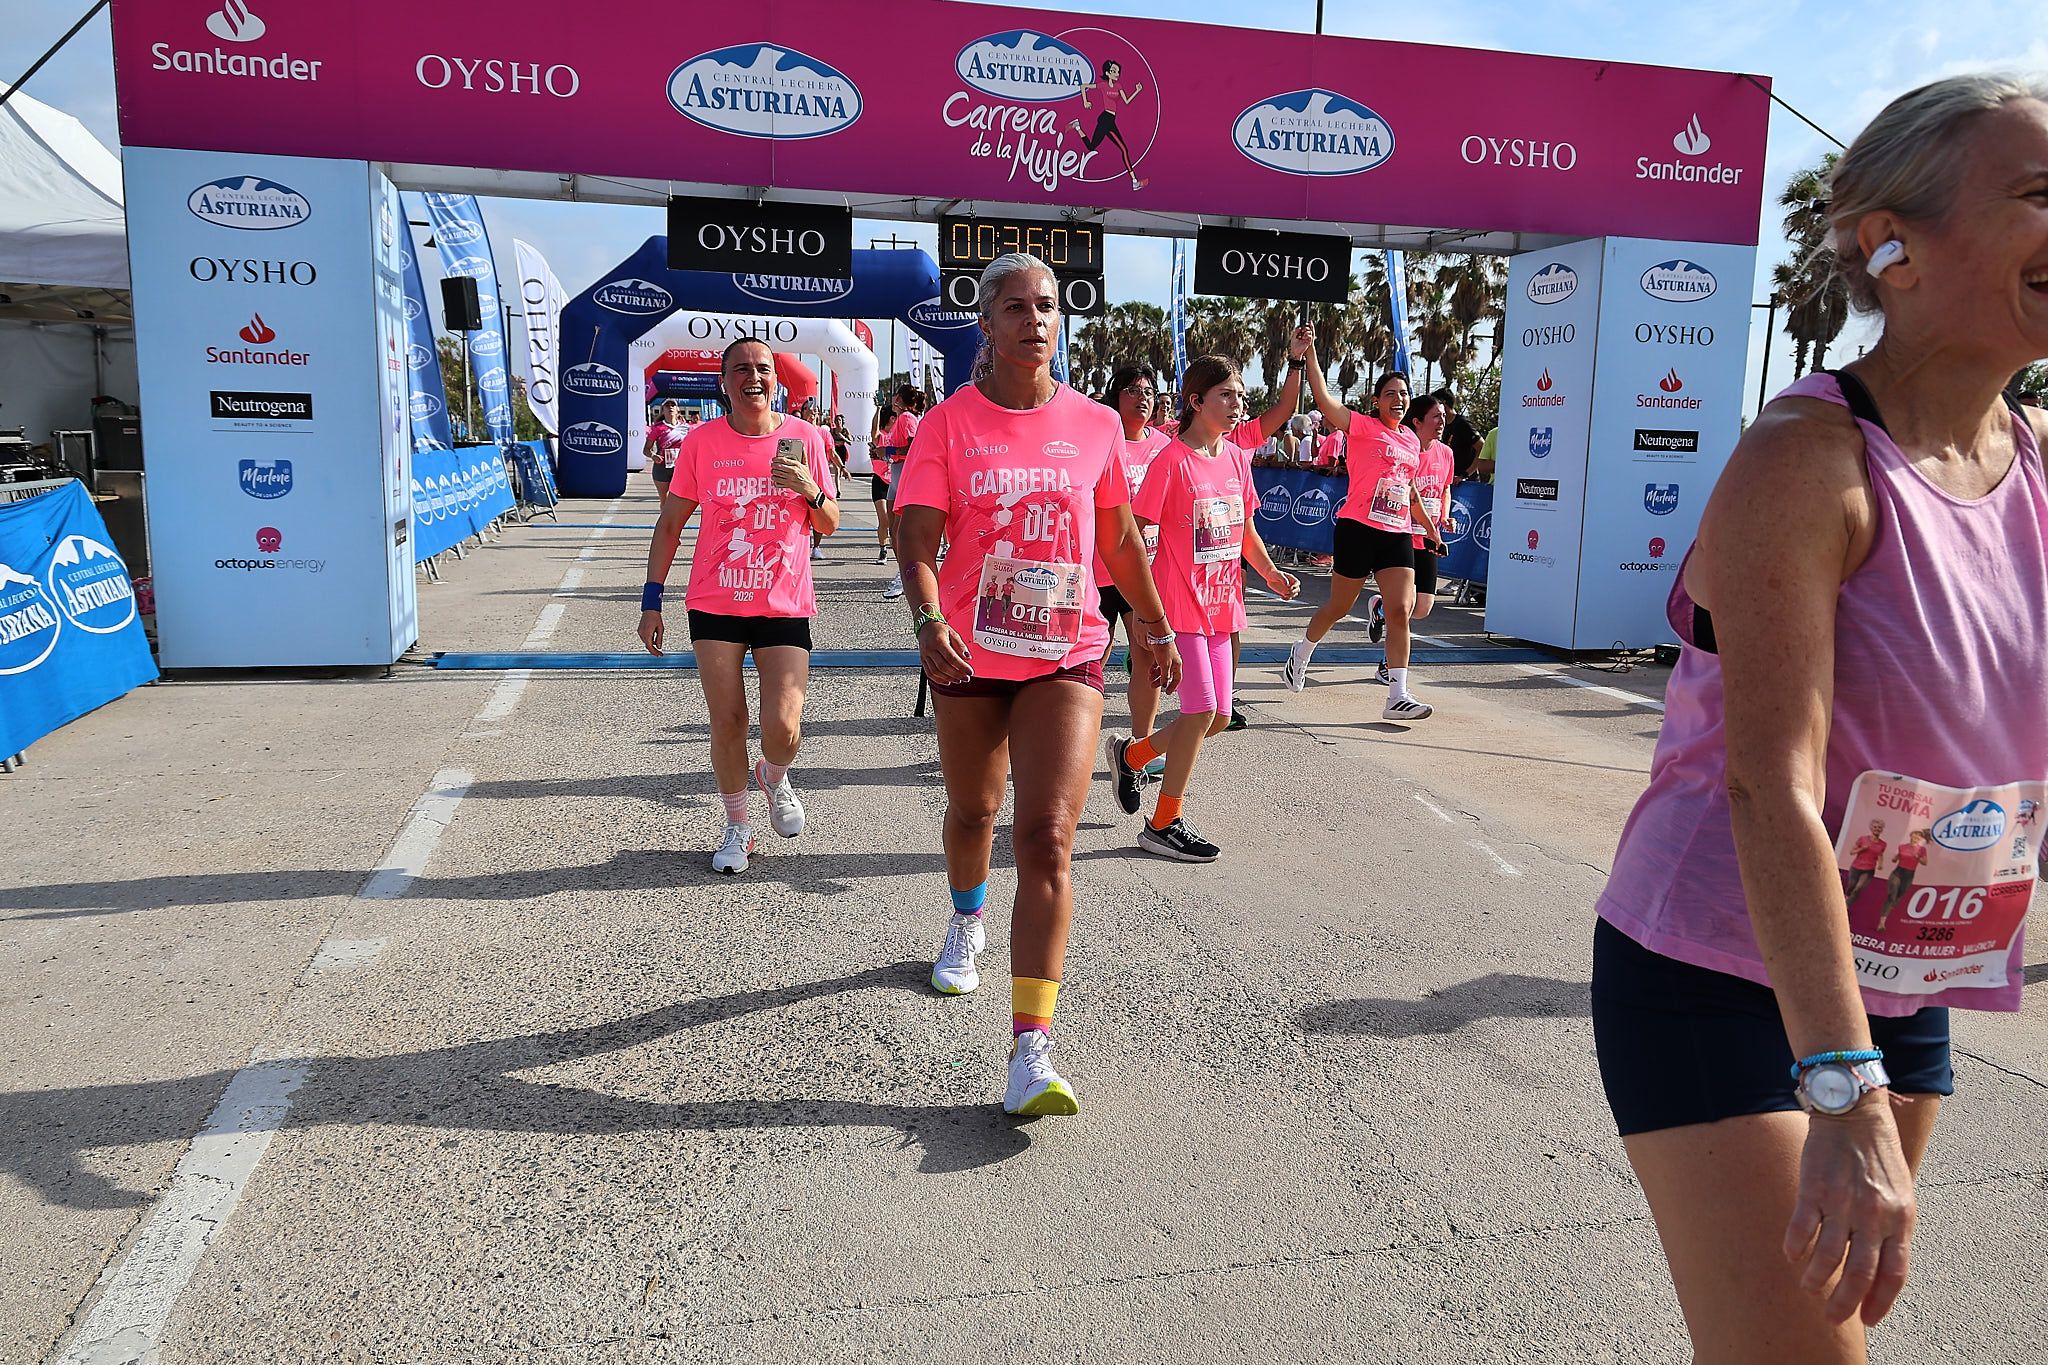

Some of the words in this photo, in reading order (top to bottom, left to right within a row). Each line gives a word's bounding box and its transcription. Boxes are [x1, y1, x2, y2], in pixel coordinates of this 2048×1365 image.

[151, 43, 322, 81] Santander
[966, 51, 1083, 86] ASTURIANA
[988, 51, 1032, 62] CENTRAL
[1036, 56, 1080, 66] LECHERA
[415, 54, 580, 98] OYSHO
[713, 72, 774, 86] CENTRAL
[781, 78, 842, 92] LECHERA
[683, 73, 848, 118] ASTURIANA
[943, 91, 1057, 135] Carrera
[1271, 117, 1323, 128] CENTRAL
[1328, 120, 1378, 132] LECHERA
[1245, 117, 1382, 157] ASTURIANA
[970, 132, 992, 157] de
[997, 132, 1012, 159] la
[1008, 132, 1098, 192] Mujer
[1460, 135, 1577, 171] OYSHO
[1635, 156, 1743, 186] Santander
[197, 193, 303, 219] ASTURIANA
[698, 222, 825, 257] OYSHO
[952, 223, 1092, 264] 00:36:07
[190, 256, 317, 286] OYSHO
[1221, 249, 1329, 281] OYSHO
[742, 274, 844, 293] ASTURIANA
[1530, 280, 1574, 297] ASTURIANA
[1646, 273, 1711, 293] ASTURIANA
[599, 290, 667, 308] ASTURIANA
[688, 316, 797, 343] OYSHO
[1522, 323, 1575, 347] OYSHO
[1635, 323, 1714, 346] OYSHO
[206, 347, 310, 365] Santander
[667, 349, 698, 359] Sports
[828, 345, 860, 354] OYSHO
[566, 373, 620, 390] ASTURIANA
[216, 396, 307, 416] Neutrogena
[1522, 394, 1566, 408] Santander
[1636, 394, 1702, 409] Santander
[566, 432, 619, 448] ASTURIANA
[1639, 434, 1694, 450] Neutrogena
[965, 444, 1009, 458] OYSHO
[714, 459, 745, 469] OYSHO
[242, 468, 290, 489] Marlene
[970, 468, 1071, 497] CARRERA
[1519, 483, 1555, 497] Neutrogena
[1387, 501, 1402, 511] 016
[1146, 536, 1158, 547] 01
[1213, 526, 1231, 538] 016
[215, 558, 275, 572] octopus
[276, 559, 326, 573] energy
[1509, 551, 1534, 564] octopus
[1620, 562, 1659, 573] octopus
[1659, 563, 1679, 571] ener
[719, 567, 775, 590] MUJER
[60, 575, 132, 617] ASTURIANA
[1011, 603, 1051, 624] 016
[984, 636, 1017, 649] OYSHO
[1879, 784, 1892, 794] TU
[1893, 788, 1934, 805] DORSAL
[1877, 793, 1930, 819] SUMA
[1906, 887, 1988, 919] 016
[1916, 927, 1955, 941] 3286
[1889, 943, 1906, 954] DE
[1906, 944, 1920, 955] LA
[1922, 945, 1956, 956] MUJER
